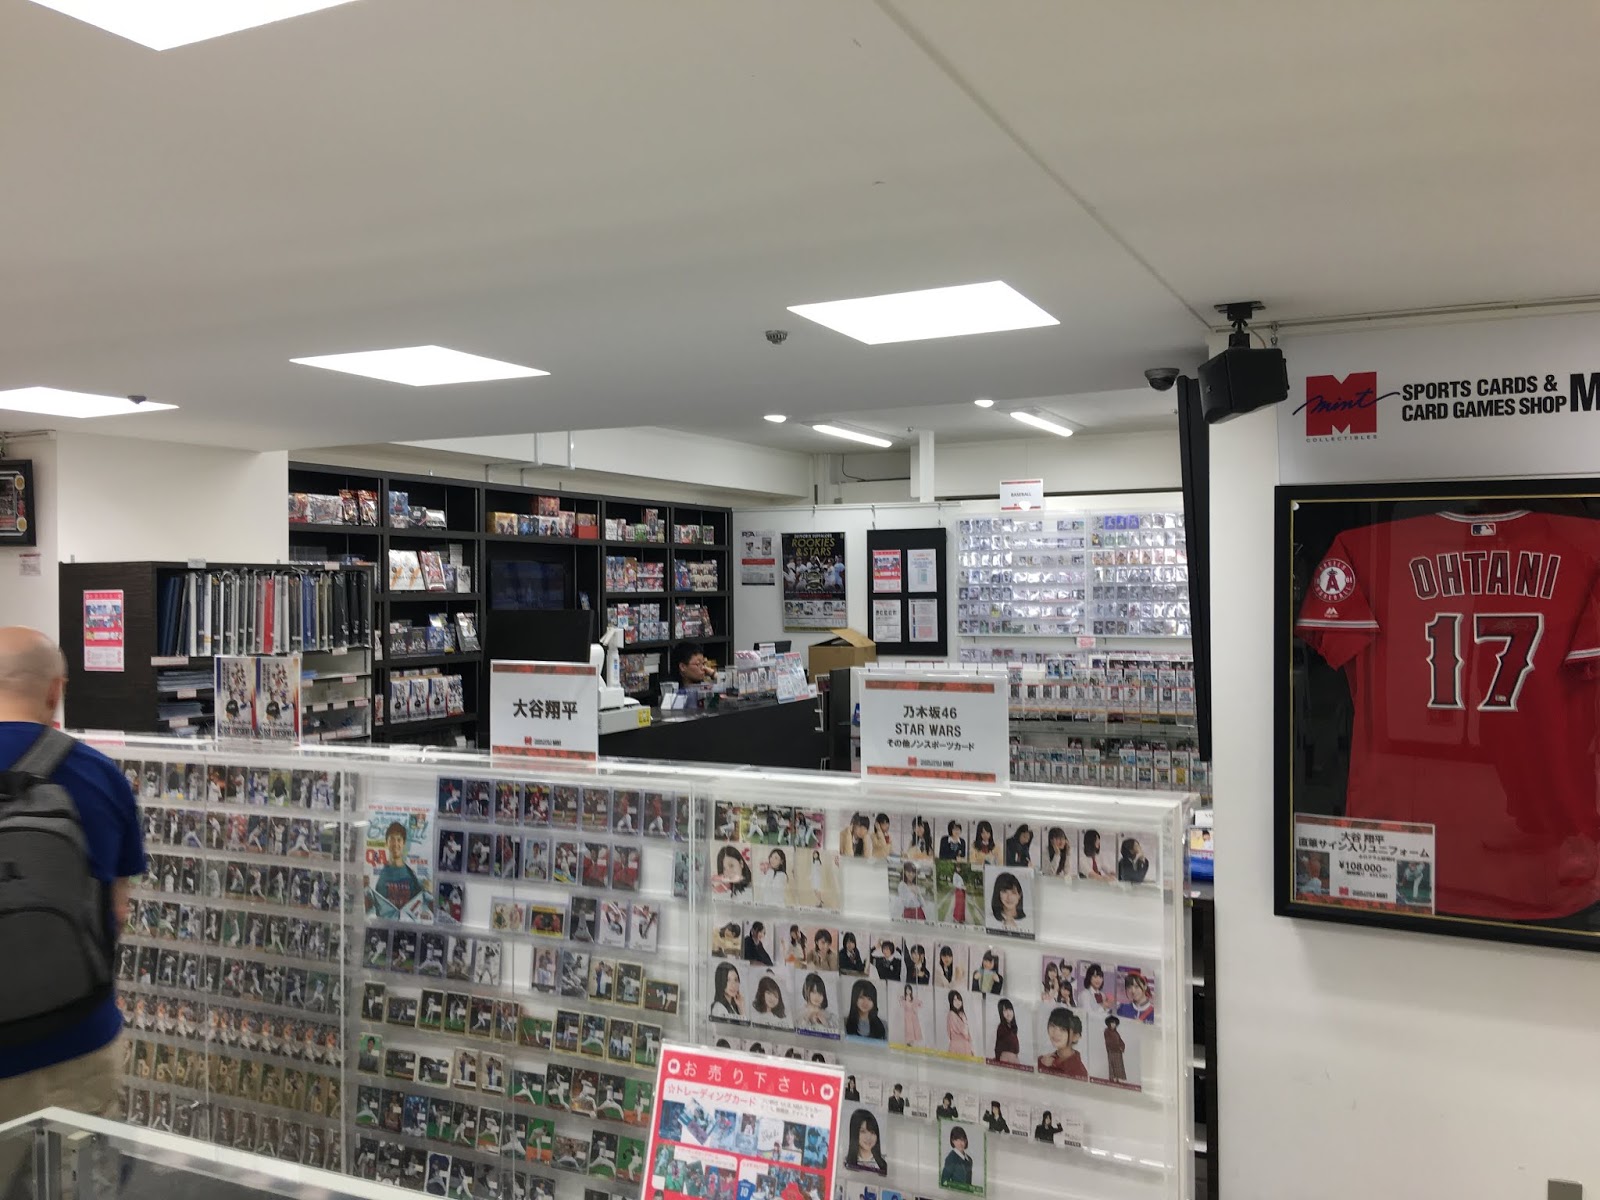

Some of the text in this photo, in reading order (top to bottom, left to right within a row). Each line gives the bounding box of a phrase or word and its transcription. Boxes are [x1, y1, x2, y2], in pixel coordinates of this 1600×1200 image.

[1402, 375, 1558, 401] SPORTS CARDS &
[1402, 395, 1567, 421] CARD GAMES SHOP
[1306, 434, 1378, 443] COLLECTIBLES
[792, 538, 835, 547] ROOKIES
[1409, 551, 1561, 601] OHTANI
[1425, 613, 1544, 712] 17
[513, 698, 578, 720] 大谷翔平
[903, 705, 957, 719] 乃木坂46
[895, 723, 961, 737] STAR WARS
[887, 739, 975, 752] その他ノンスポーツカード
[366, 849, 388, 867] Q&A
[684, 1060, 815, 1096] お売り下さい
